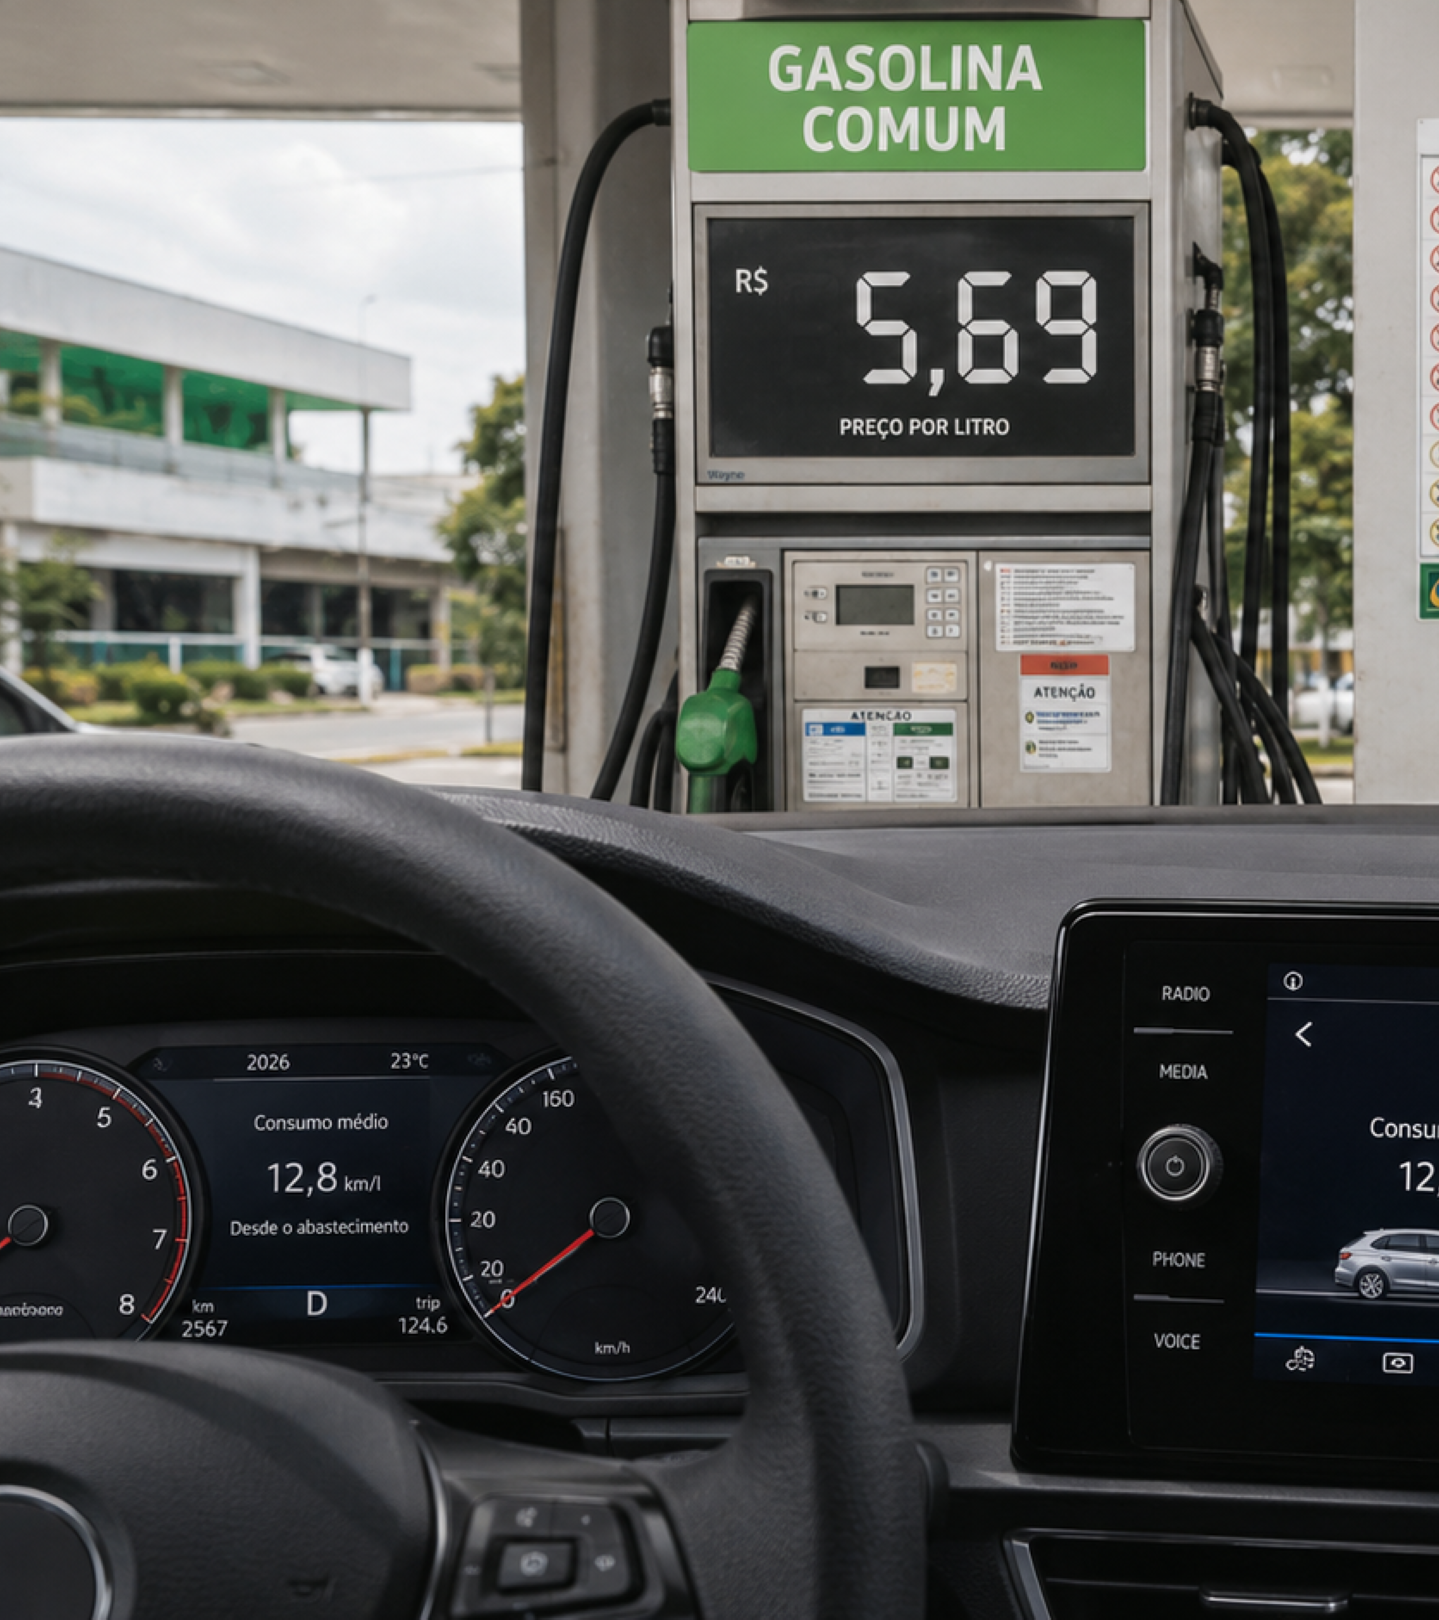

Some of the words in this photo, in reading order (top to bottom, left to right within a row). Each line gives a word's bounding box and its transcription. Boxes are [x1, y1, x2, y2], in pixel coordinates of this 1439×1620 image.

[768, 44, 1043, 92] GASOLINA
[802, 105, 1006, 153] COMUM
[735, 266, 769, 296] R$
[856, 270, 1097, 397] 5,69
[840, 417, 904, 440] PREÇO
[909, 417, 949, 436] POR
[954, 417, 1010, 436] LITRO
[1034, 683, 1096, 702] ATENÇÃO
[1162, 985, 1211, 1003] RADIO
[246, 1053, 291, 1071] 2026
[391, 1052, 429, 1070] 23°C
[1159, 1063, 1209, 1080] MEDIA
[542, 1089, 575, 1108] 160
[96, 1106, 112, 1128] 5
[253, 1114, 333, 1132] Consumo
[337, 1112, 389, 1130] médio
[505, 1117, 532, 1135] 40
[141, 1158, 158, 1180] 6
[477, 1159, 505, 1178] 40
[267, 1161, 338, 1198] 12,8
[344, 1175, 381, 1192] km/l
[230, 1219, 279, 1237] Desde
[282, 1222, 293, 1235] o
[296, 1218, 409, 1235] abastecimento
[470, 1210, 496, 1229] 20
[152, 1228, 168, 1250] 7
[480, 1259, 504, 1278] 20
[1152, 1250, 1206, 1268] PHONE
[119, 1293, 135, 1316] 8
[192, 1299, 215, 1313] km
[307, 1290, 328, 1316] D
[415, 1296, 441, 1313] trip
[181, 1319, 228, 1338] 2567
[398, 1315, 448, 1335] 124.6
[594, 1340, 631, 1355] km/h
[1153, 1332, 1201, 1350] VOICE
